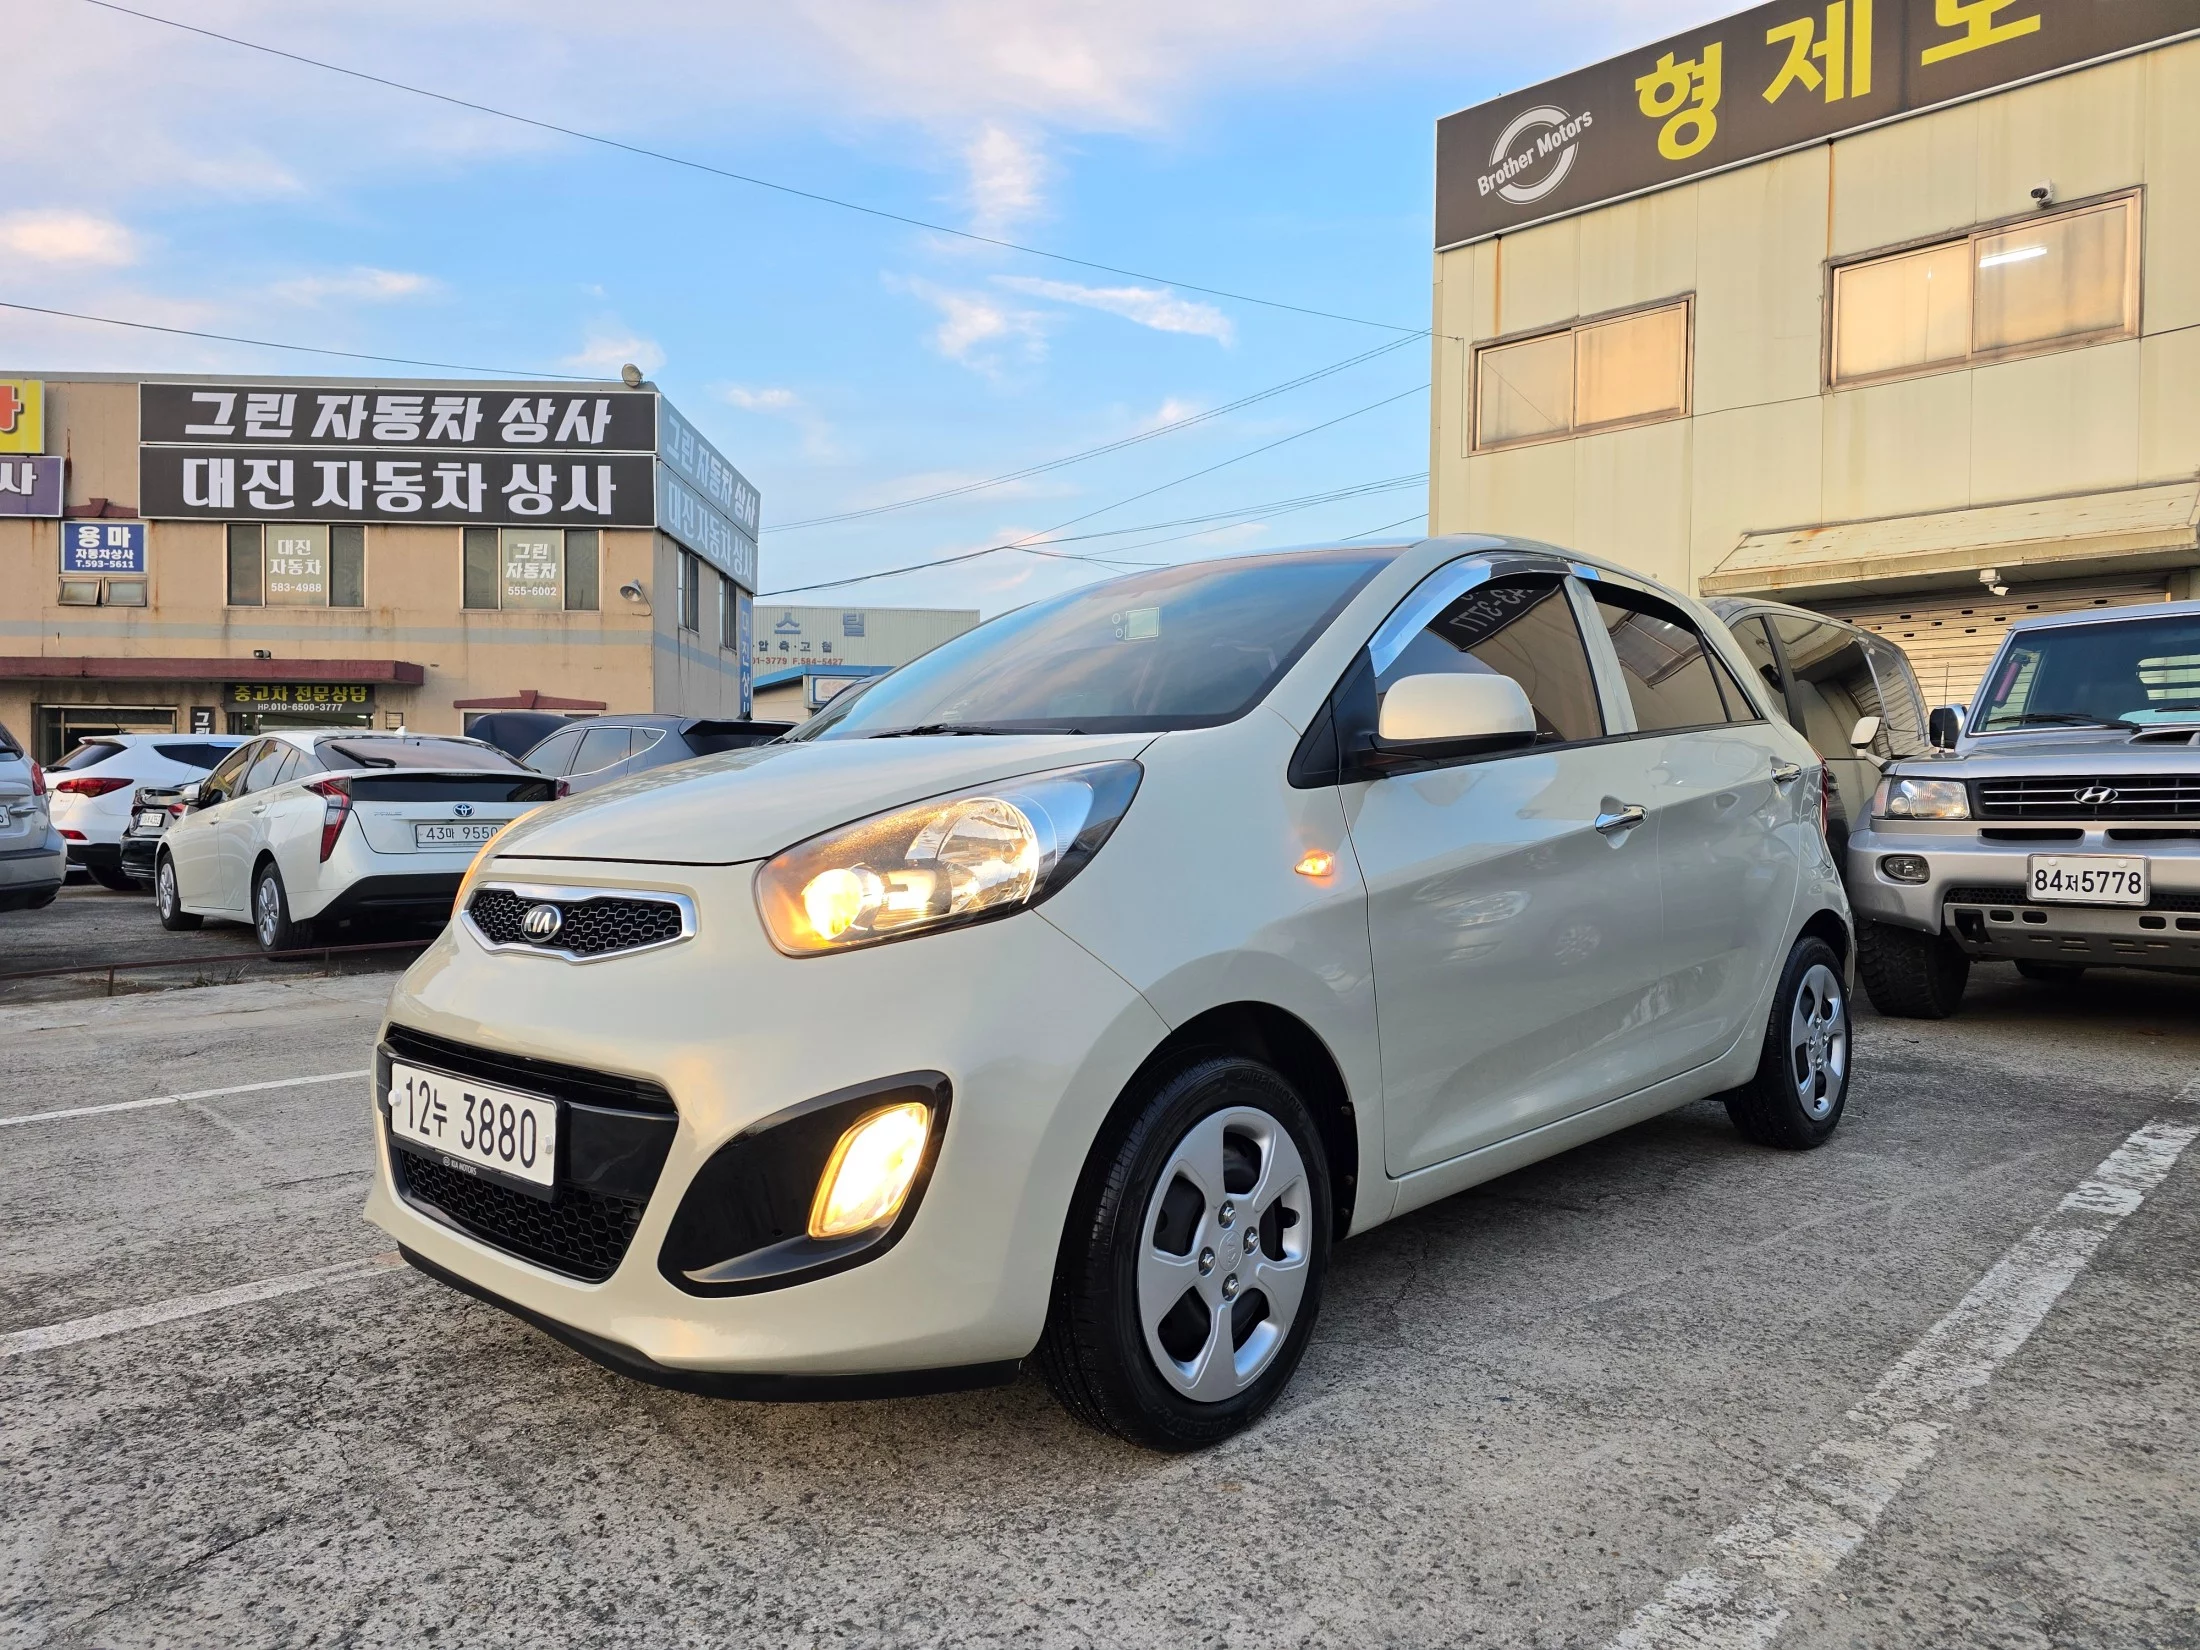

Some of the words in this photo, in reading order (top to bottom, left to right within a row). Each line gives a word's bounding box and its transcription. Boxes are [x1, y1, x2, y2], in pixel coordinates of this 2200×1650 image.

[1477, 147, 1534, 196] Brother
[1536, 111, 1593, 158] Motors
[185, 392, 298, 439] 그린
[310, 395, 484, 443] 자동차
[497, 397, 611, 445] 상사
[667, 414, 694, 474] 그린
[696, 443, 733, 509] 자동차
[734, 481, 756, 529] 상사
[182, 457, 294, 511] 대진
[311, 460, 488, 514] 자동차
[501, 463, 617, 516] 상사
[668, 480, 694, 539] 대진
[697, 504, 732, 568] 자동차
[733, 536, 753, 583] 상사
[75, 548, 134, 560] 자동차상사
[277, 539, 311, 556] 대진
[515, 543, 548, 560] 그린
[75, 560, 134, 568] T.593-5611
[269, 558, 322, 575] 자동차
[506, 562, 556, 579] 자동차
[271, 582, 322, 592] 583-4988
[508, 586, 556, 596] 555-6002
[234, 685, 289, 702] 중고차
[295, 685, 368, 703] 전문상담
[257, 703, 343, 712] HP.010-6500-3777
[426, 827, 454, 840] 43마
[462, 826, 498, 840] 9550
[2034, 869, 2142, 895] 84저5778
[524, 910, 552, 934] KIA
[405, 1076, 448, 1138] 12누
[460, 1092, 537, 1169] 3880
